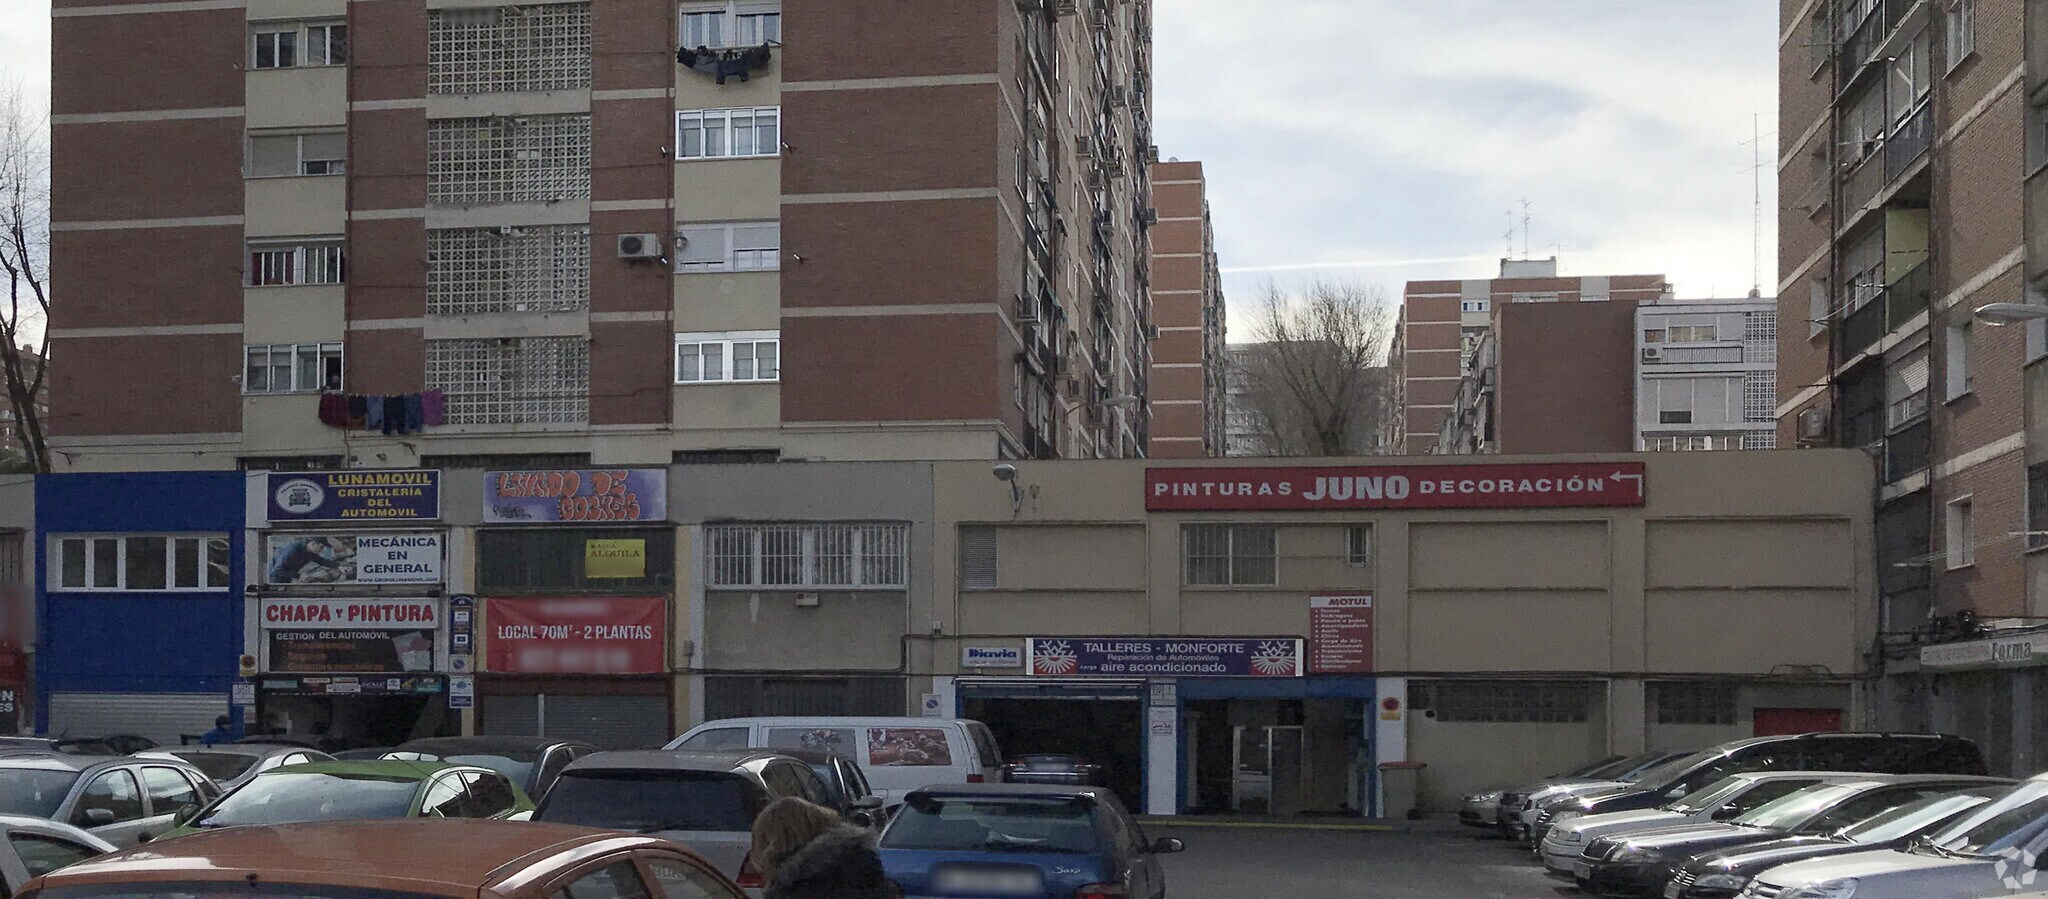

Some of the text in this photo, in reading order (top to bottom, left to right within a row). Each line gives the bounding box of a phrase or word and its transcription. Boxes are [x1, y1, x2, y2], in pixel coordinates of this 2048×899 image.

[328, 473, 432, 485] LUNAMOVIL
[591, 469, 628, 496] DE
[338, 487, 422, 497] CRISTALERÍA
[1154, 475, 1604, 500] PINTURAS JUNO DECORACIÓN
[368, 498, 391, 507] DEL
[341, 509, 418, 517] AUTOMOVIL
[359, 536, 437, 548] MECÁNICA
[388, 551, 408, 560] EN
[363, 564, 433, 574] GENERAL
[1329, 598, 1368, 606] MOTUL
[266, 604, 434, 622] CHAPA Y PINTURA
[498, 625, 537, 640] LOCAL
[584, 626, 592, 639] 2
[596, 625, 652, 639] PLANTAS
[1083, 642, 1152, 653] TALLERES
[1165, 643, 1245, 653] MONFORTE
[968, 648, 1018, 658] Diavia
[1107, 653, 1153, 661] Reparación
[1101, 661, 1126, 672] aire
[1129, 662, 1227, 672] acondicionado
